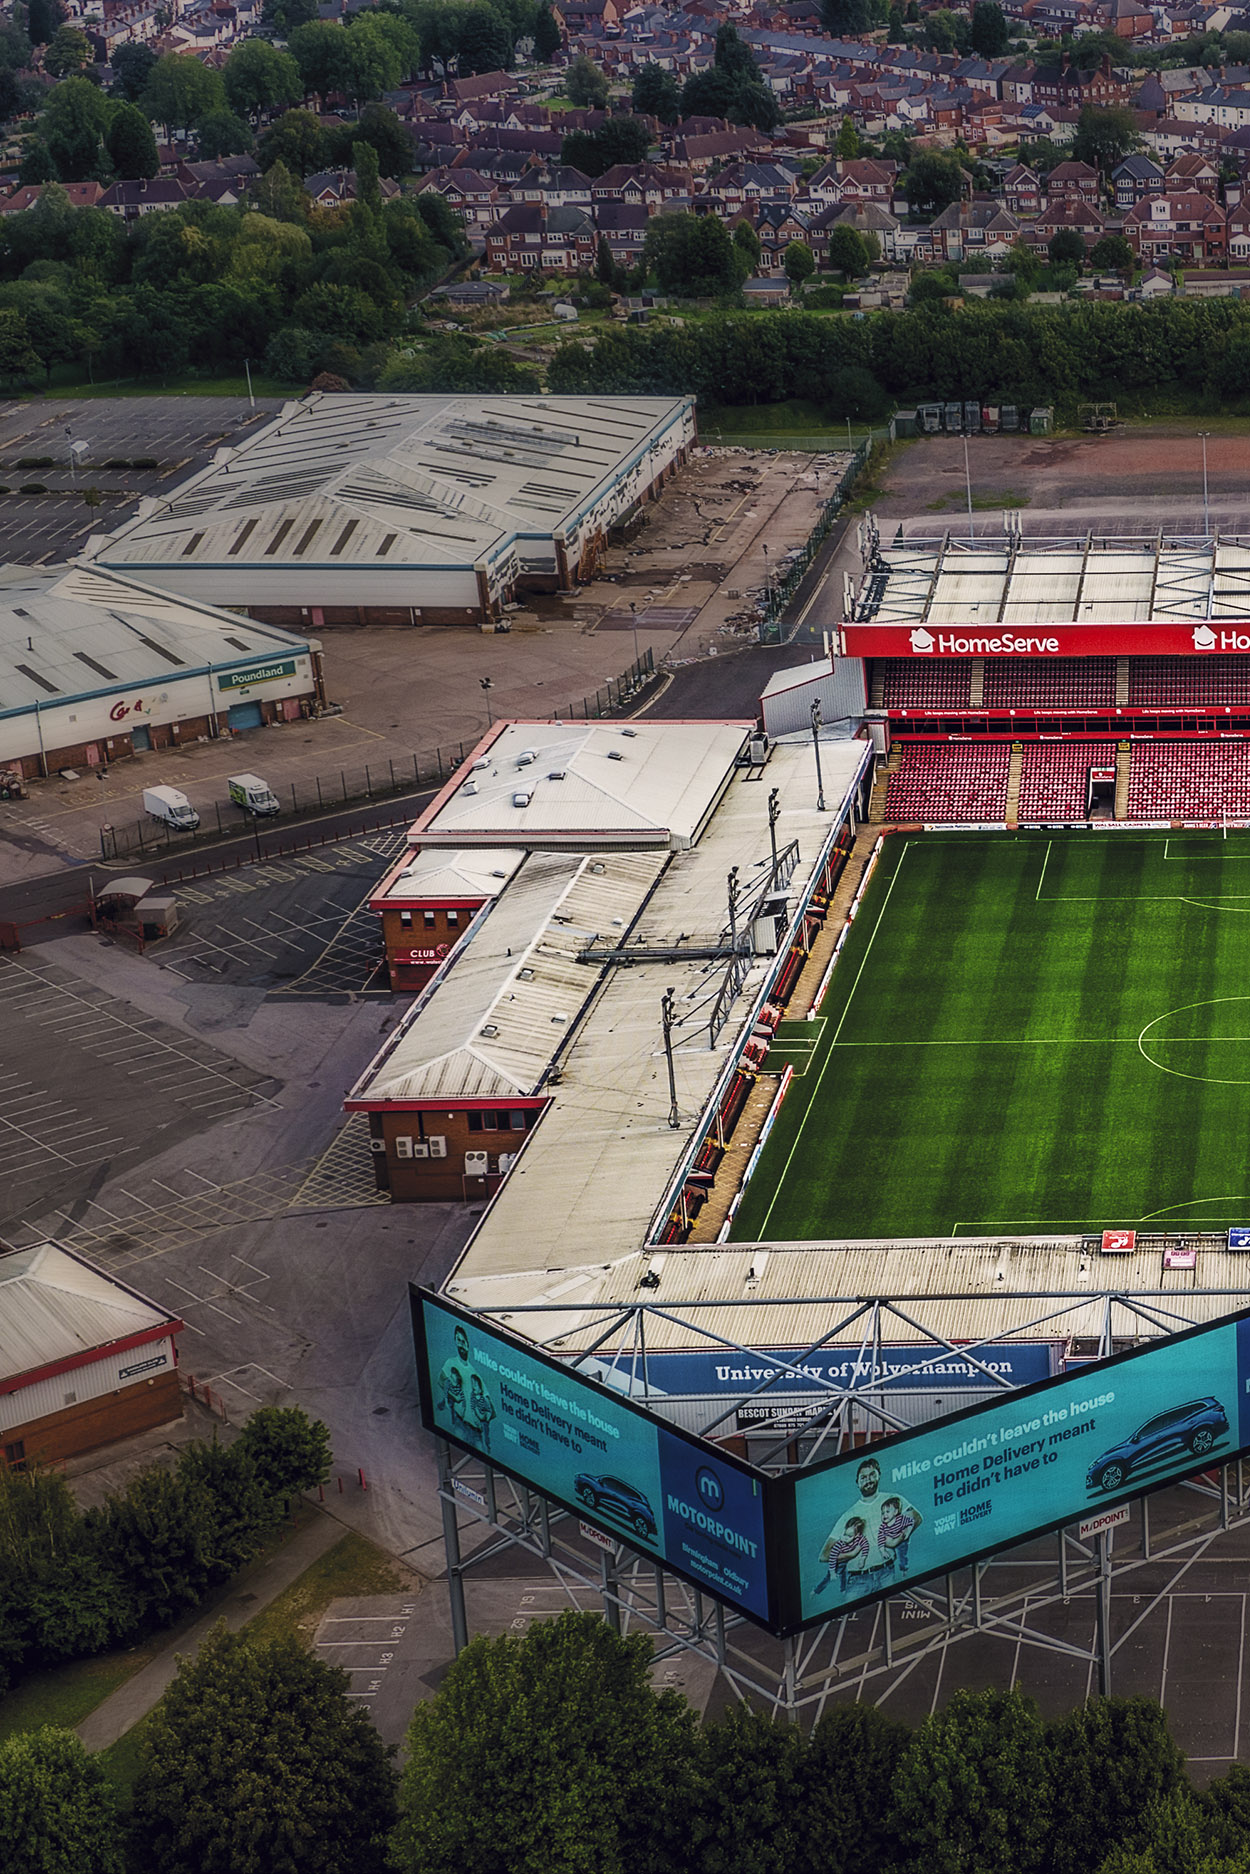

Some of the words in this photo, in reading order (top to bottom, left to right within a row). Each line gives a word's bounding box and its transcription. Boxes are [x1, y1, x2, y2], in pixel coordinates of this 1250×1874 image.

[938, 634, 1059, 653] HomeServe
[232, 665, 284, 685] Poundland
[410, 950, 436, 958] CLUB
[828, 1362, 850, 1378] of
[474, 1347, 498, 1372] Mike
[498, 1365, 541, 1396] couldn't
[540, 1384, 568, 1410] leave
[568, 1401, 586, 1421] the
[588, 1409, 620, 1439] house
[500, 1382, 530, 1409] Home
[531, 1400, 572, 1434] Delivery
[574, 1426, 608, 1453] meant
[738, 1408, 770, 1418] BESCOT
[501, 1398, 514, 1415] he
[515, 1408, 545, 1434] didn't
[545, 1424, 570, 1447] have
[571, 1440, 582, 1454] to
[891, 1460, 931, 1482] Mike
[934, 1432, 998, 1467] couldn't
[1000, 1417, 1041, 1443] leave
[1042, 1407, 1068, 1425] the
[1070, 1391, 1115, 1417] house
[933, 1464, 979, 1490] Home
[983, 1438, 1045, 1470] Delivery
[1048, 1418, 1096, 1446] meant
[934, 1490, 953, 1506] he
[956, 1470, 1000, 1497] didn't
[1004, 1456, 1040, 1481] have
[1043, 1451, 1058, 1465] to
[960, 1500, 992, 1518] HOME
[960, 1508, 992, 1526] DELIVERY
[667, 1494, 758, 1558] MOTORPOINT
[401, 1603, 416, 1614] H1
[390, 1626, 406, 1637] H2
[379, 1652, 394, 1664] H3
[368, 1679, 382, 1691] H4
